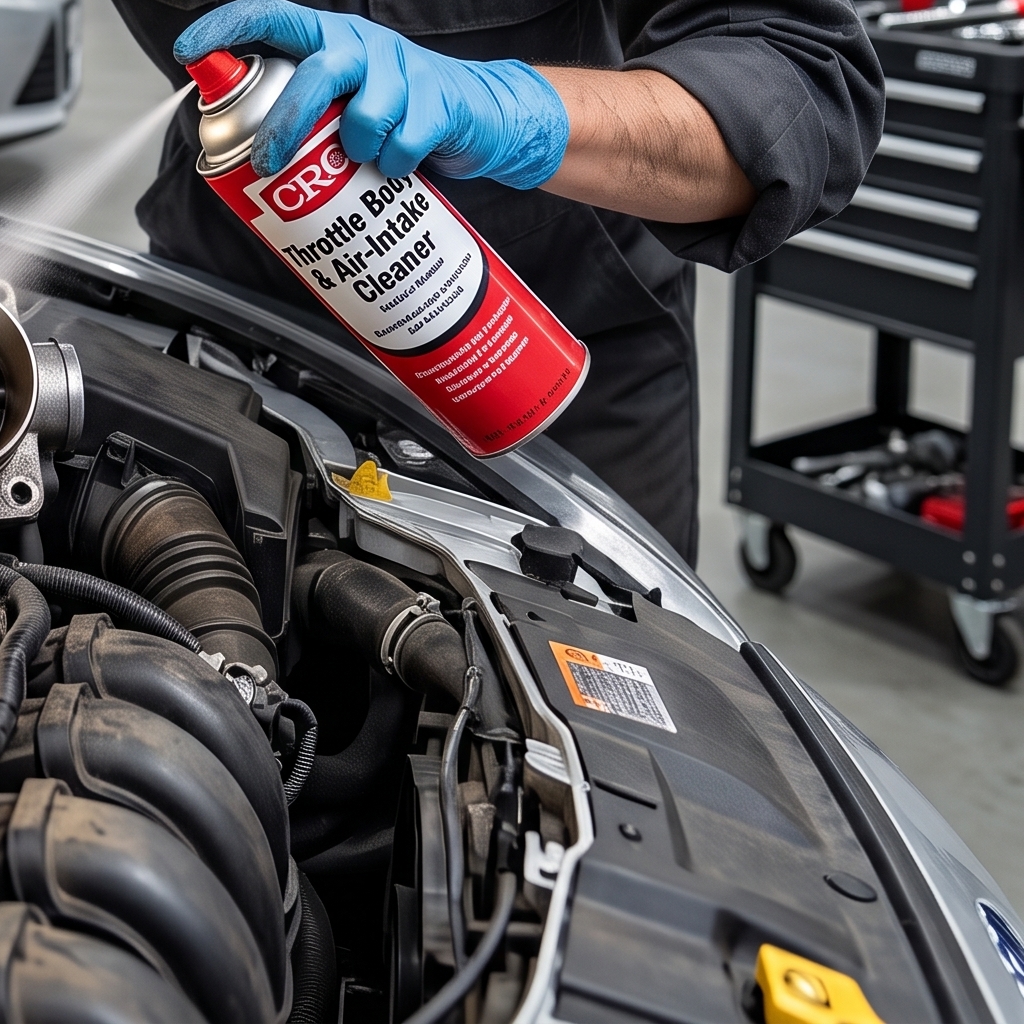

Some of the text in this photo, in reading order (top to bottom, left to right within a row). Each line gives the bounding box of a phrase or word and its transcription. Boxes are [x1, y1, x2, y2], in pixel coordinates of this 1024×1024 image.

[272, 142, 350, 212] CRC
[281, 212, 367, 268] Throttle
[310, 268, 338, 291] &
[330, 191, 430, 283] Air-Intake
[352, 229, 436, 303] Cleaner
